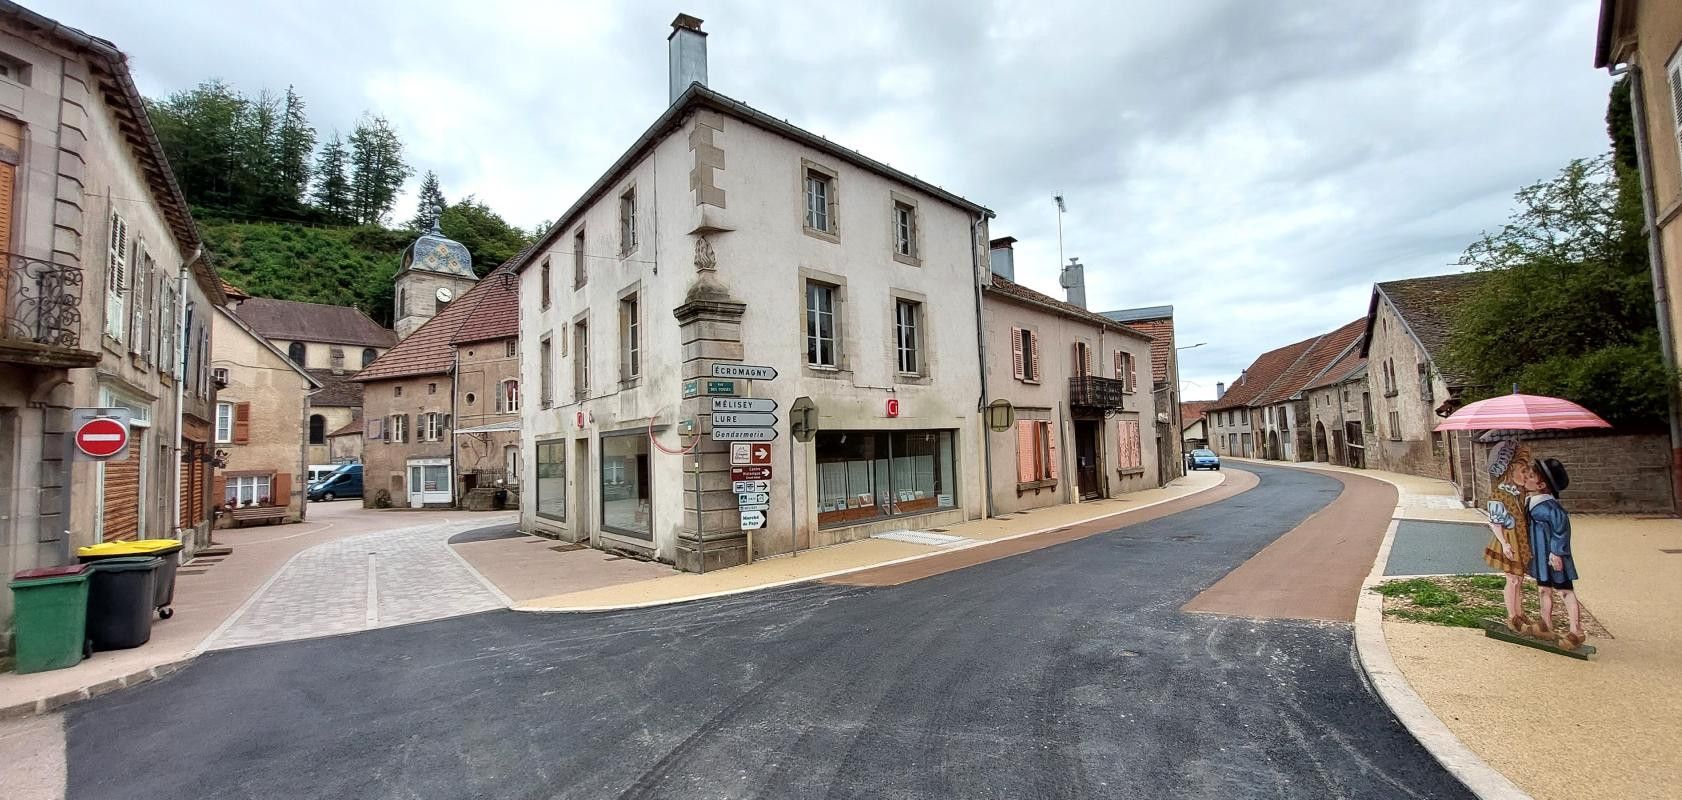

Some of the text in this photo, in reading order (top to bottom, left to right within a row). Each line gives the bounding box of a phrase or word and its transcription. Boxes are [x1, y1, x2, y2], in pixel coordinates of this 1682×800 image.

[715, 366, 767, 377] ÉCROMAGNY
[715, 400, 753, 409] MÉLISEY
[715, 415, 737, 423] LURE
[715, 430, 764, 438] Gendarmerie
